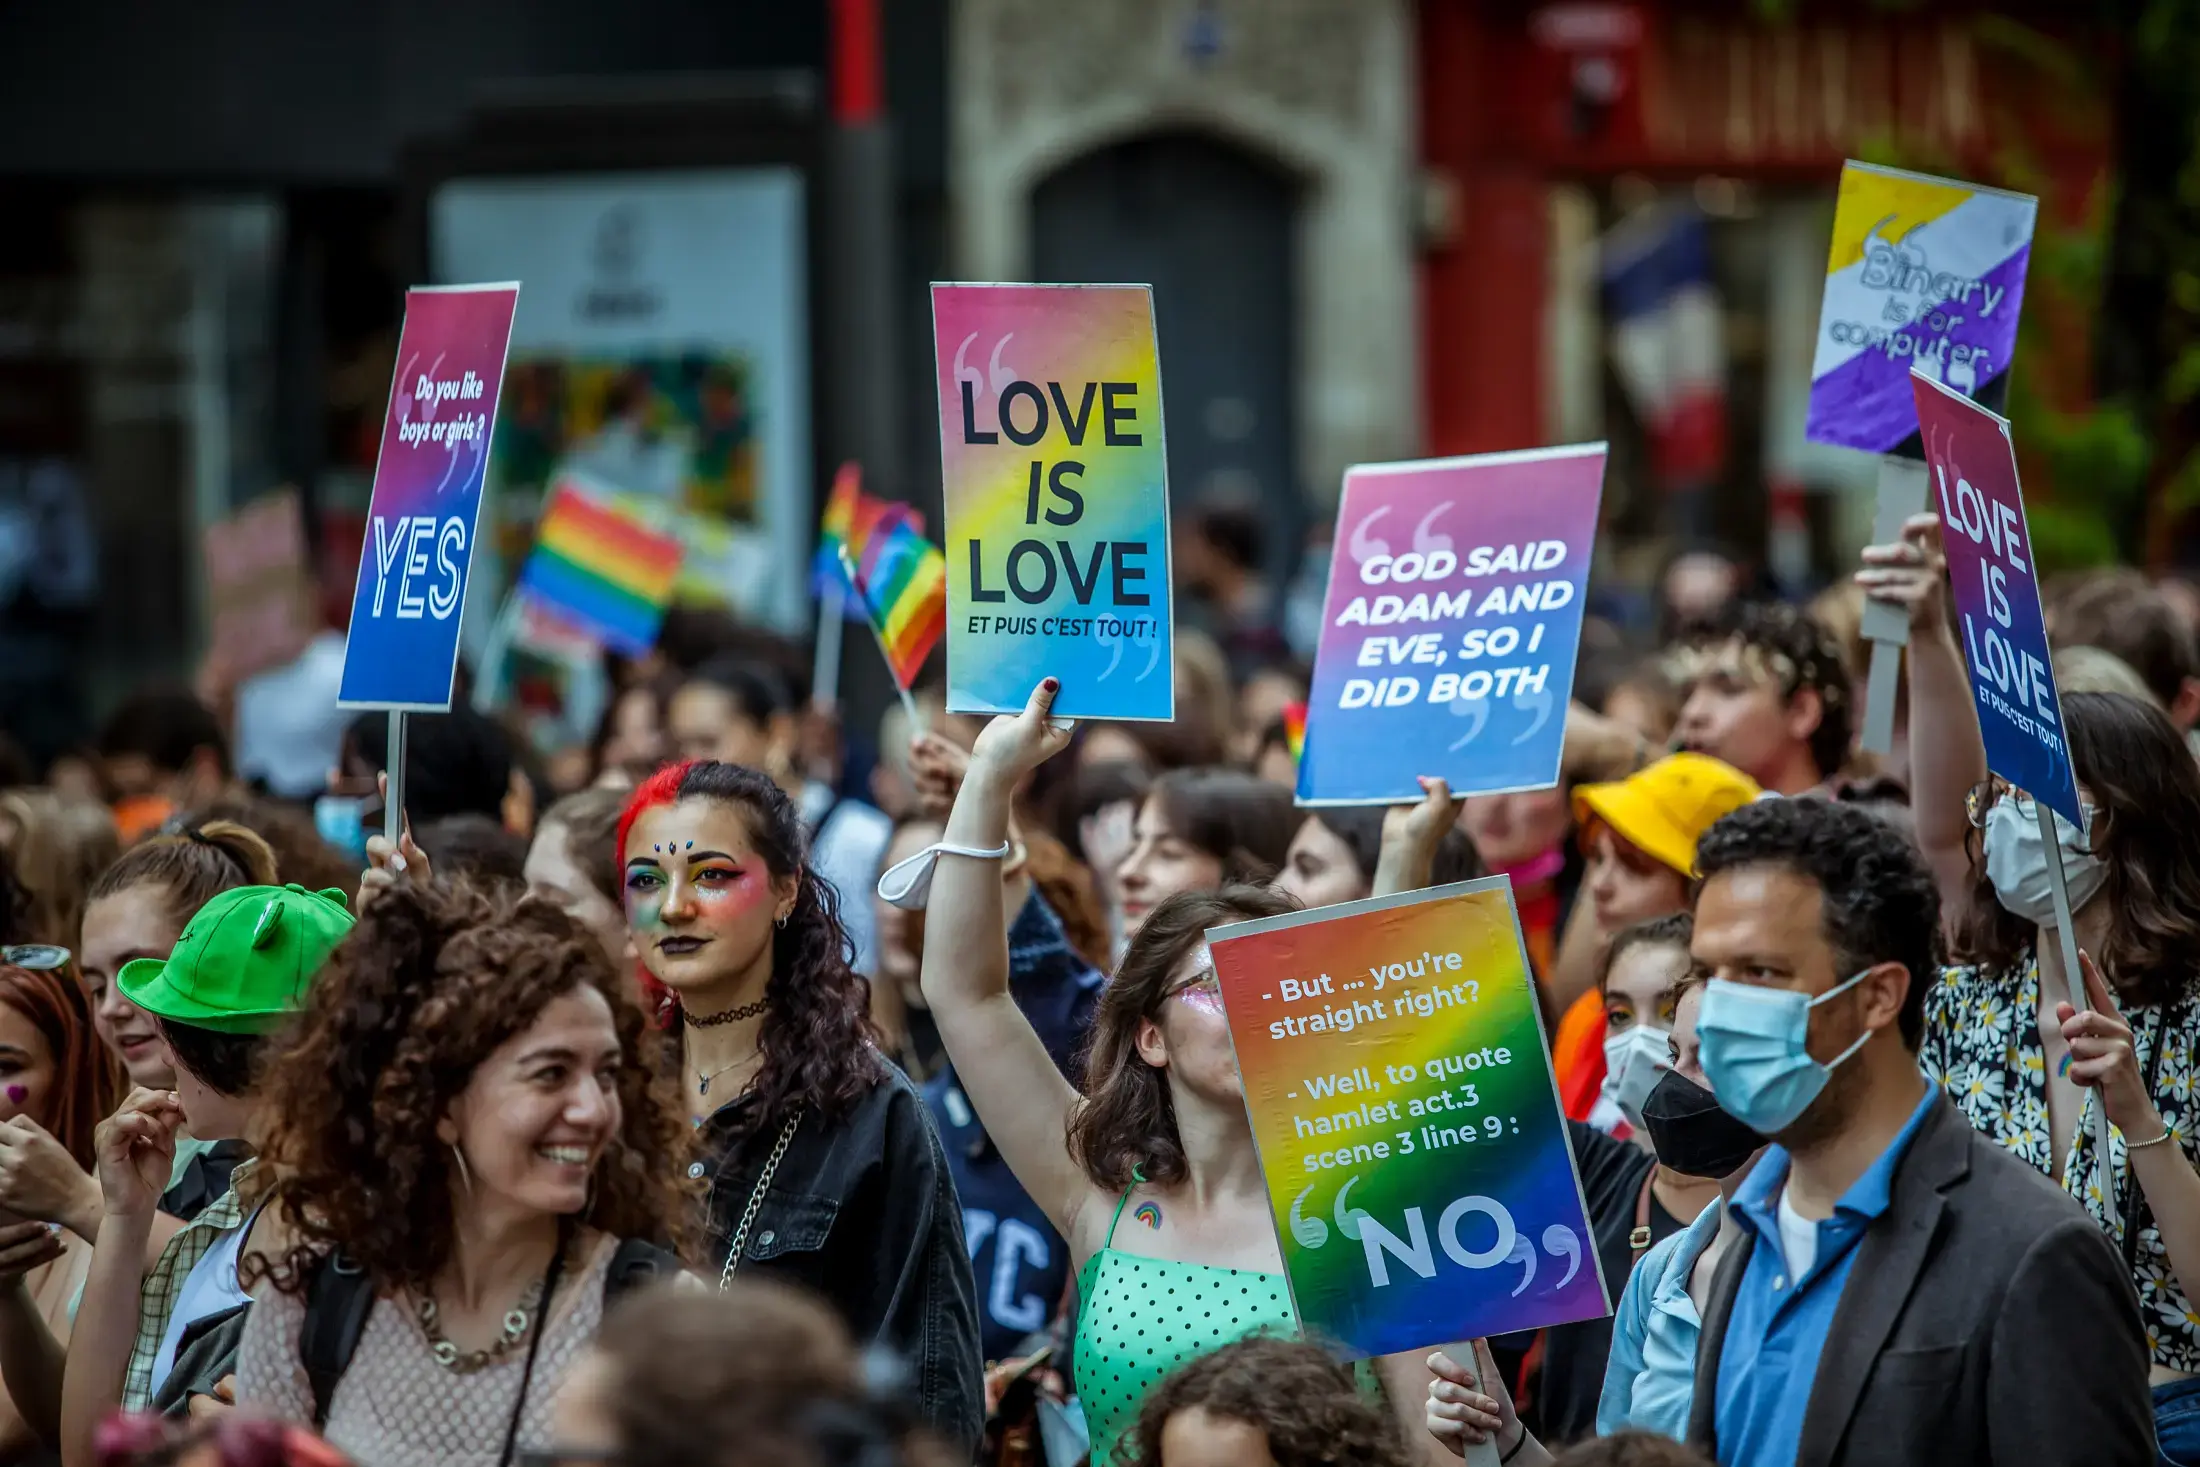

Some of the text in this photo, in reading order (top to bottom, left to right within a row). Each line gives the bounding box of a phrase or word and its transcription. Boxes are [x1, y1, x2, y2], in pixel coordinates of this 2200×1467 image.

[1860, 245, 2004, 318] Binary
[1915, 298, 1964, 333] for
[415, 370, 484, 408] Do you like
[961, 380, 1143, 447] LOVE
[399, 412, 431, 449] boys
[431, 421, 448, 441] or
[445, 411, 475, 449] girls
[1025, 460, 1086, 526] IS
[1936, 464, 2027, 574] LOVE
[372, 515, 466, 620] YES
[969, 538, 1150, 606] LOVE
[1360, 540, 1568, 586] GOD SAID
[1335, 580, 1575, 627] ADAM AND
[1980, 556, 2012, 629] IS
[968, 615, 991, 634] ET
[994, 616, 1037, 636] PUIS
[1041, 617, 1094, 637] C'EST
[1097, 619, 1148, 638] TOUT
[1357, 622, 1545, 668] EVE, SO I
[1338, 664, 1550, 709] DID BOTH
[1965, 612, 2056, 725] LOVE
[1979, 684, 1990, 706] ET
[1990, 691, 2011, 720] PUIS
[2035, 722, 2058, 752] TOUT
[1279, 972, 1336, 1002] But
[1369, 951, 1463, 991] you're
[1269, 979, 1480, 1040] straight right?
[1303, 1066, 1380, 1101] Well,
[1385, 1064, 1417, 1086] to
[1424, 1046, 1512, 1082] quote
[1294, 1083, 1480, 1139] hamlet act.3
[1303, 1139, 1390, 1173] scene
[1395, 1131, 1415, 1155] 3
[1421, 1125, 1477, 1150] line
[1483, 1115, 1504, 1139] 9
[1357, 1195, 1517, 1288] NO
